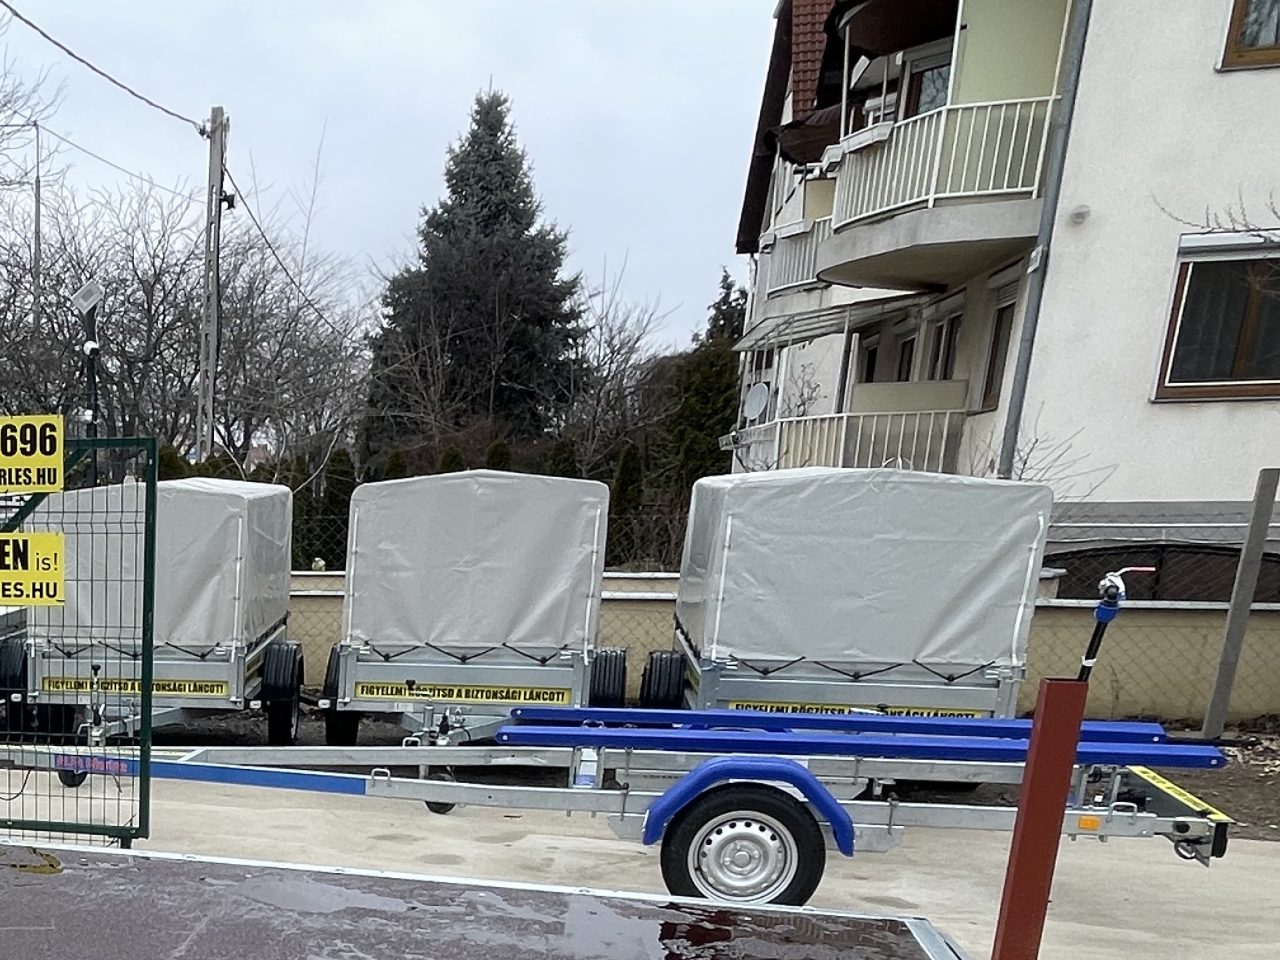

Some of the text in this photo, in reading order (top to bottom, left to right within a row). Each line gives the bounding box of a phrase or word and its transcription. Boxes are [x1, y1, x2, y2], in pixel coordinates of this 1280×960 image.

[35, 553, 59, 571] is!
[456, 689, 463, 698] A
[464, 687, 521, 700] BIZTONSÁGI
[523, 688, 565, 702] LÁNCOT!
